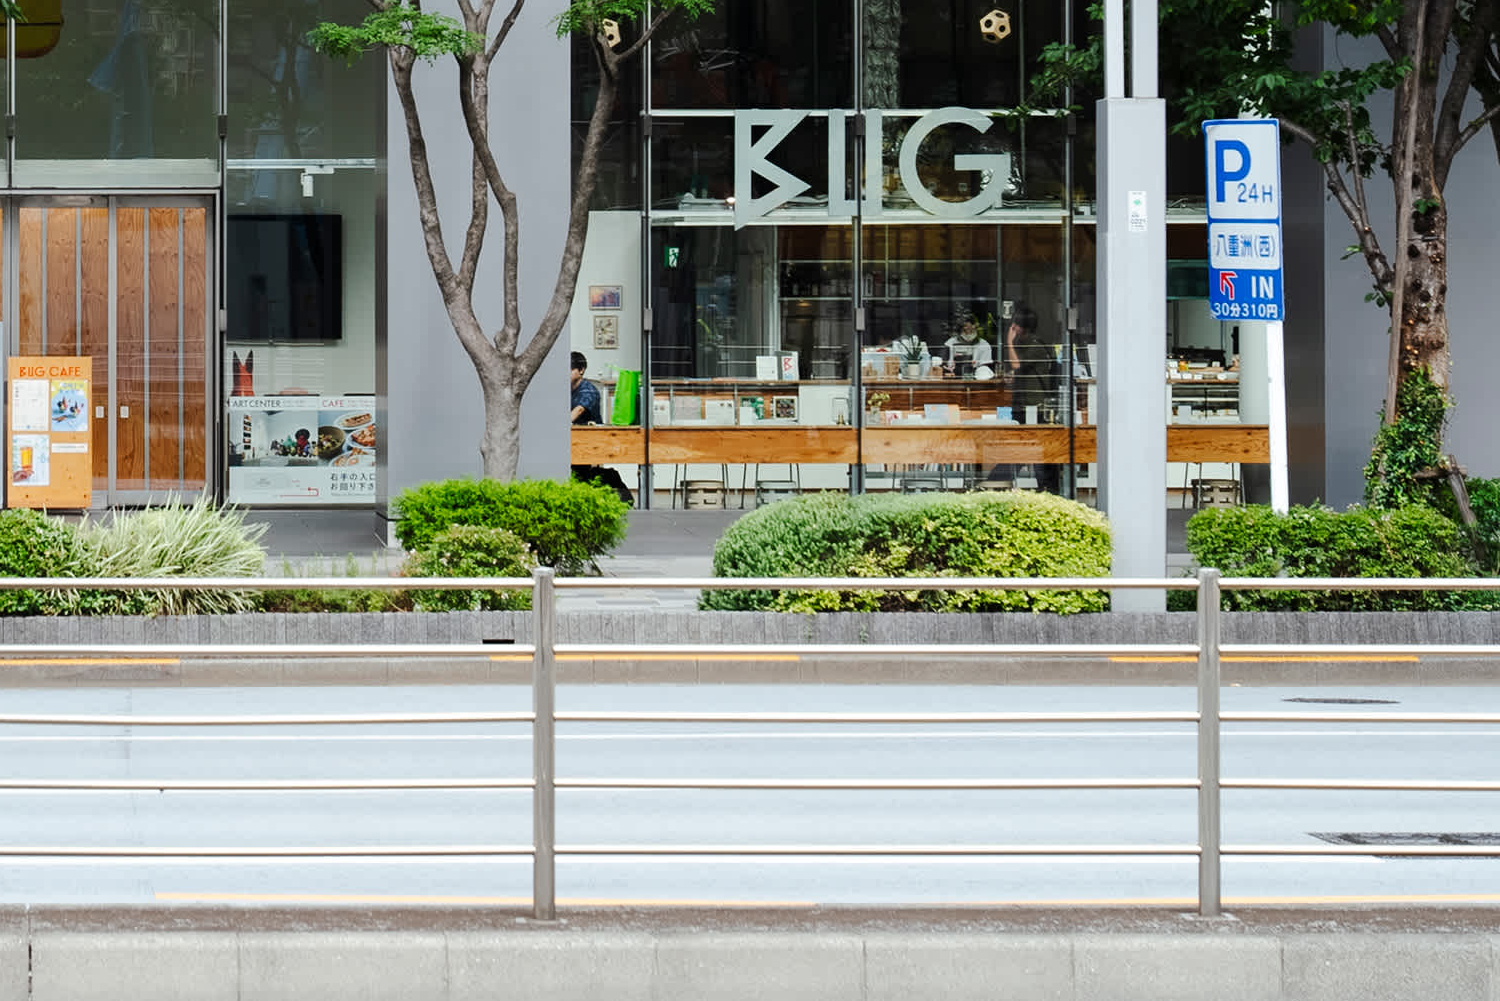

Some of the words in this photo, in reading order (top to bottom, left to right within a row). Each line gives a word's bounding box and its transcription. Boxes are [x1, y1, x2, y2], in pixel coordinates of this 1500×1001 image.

[734, 106, 1010, 231] BUG
[1215, 140, 1251, 202] P
[1237, 183, 1273, 203] 24H
[1251, 275, 1274, 299] IN
[1213, 303, 1278, 319] 30分310円
[19, 366, 45, 378] BUG
[49, 366, 81, 378] CAFE
[322, 400, 345, 408] CAFE
